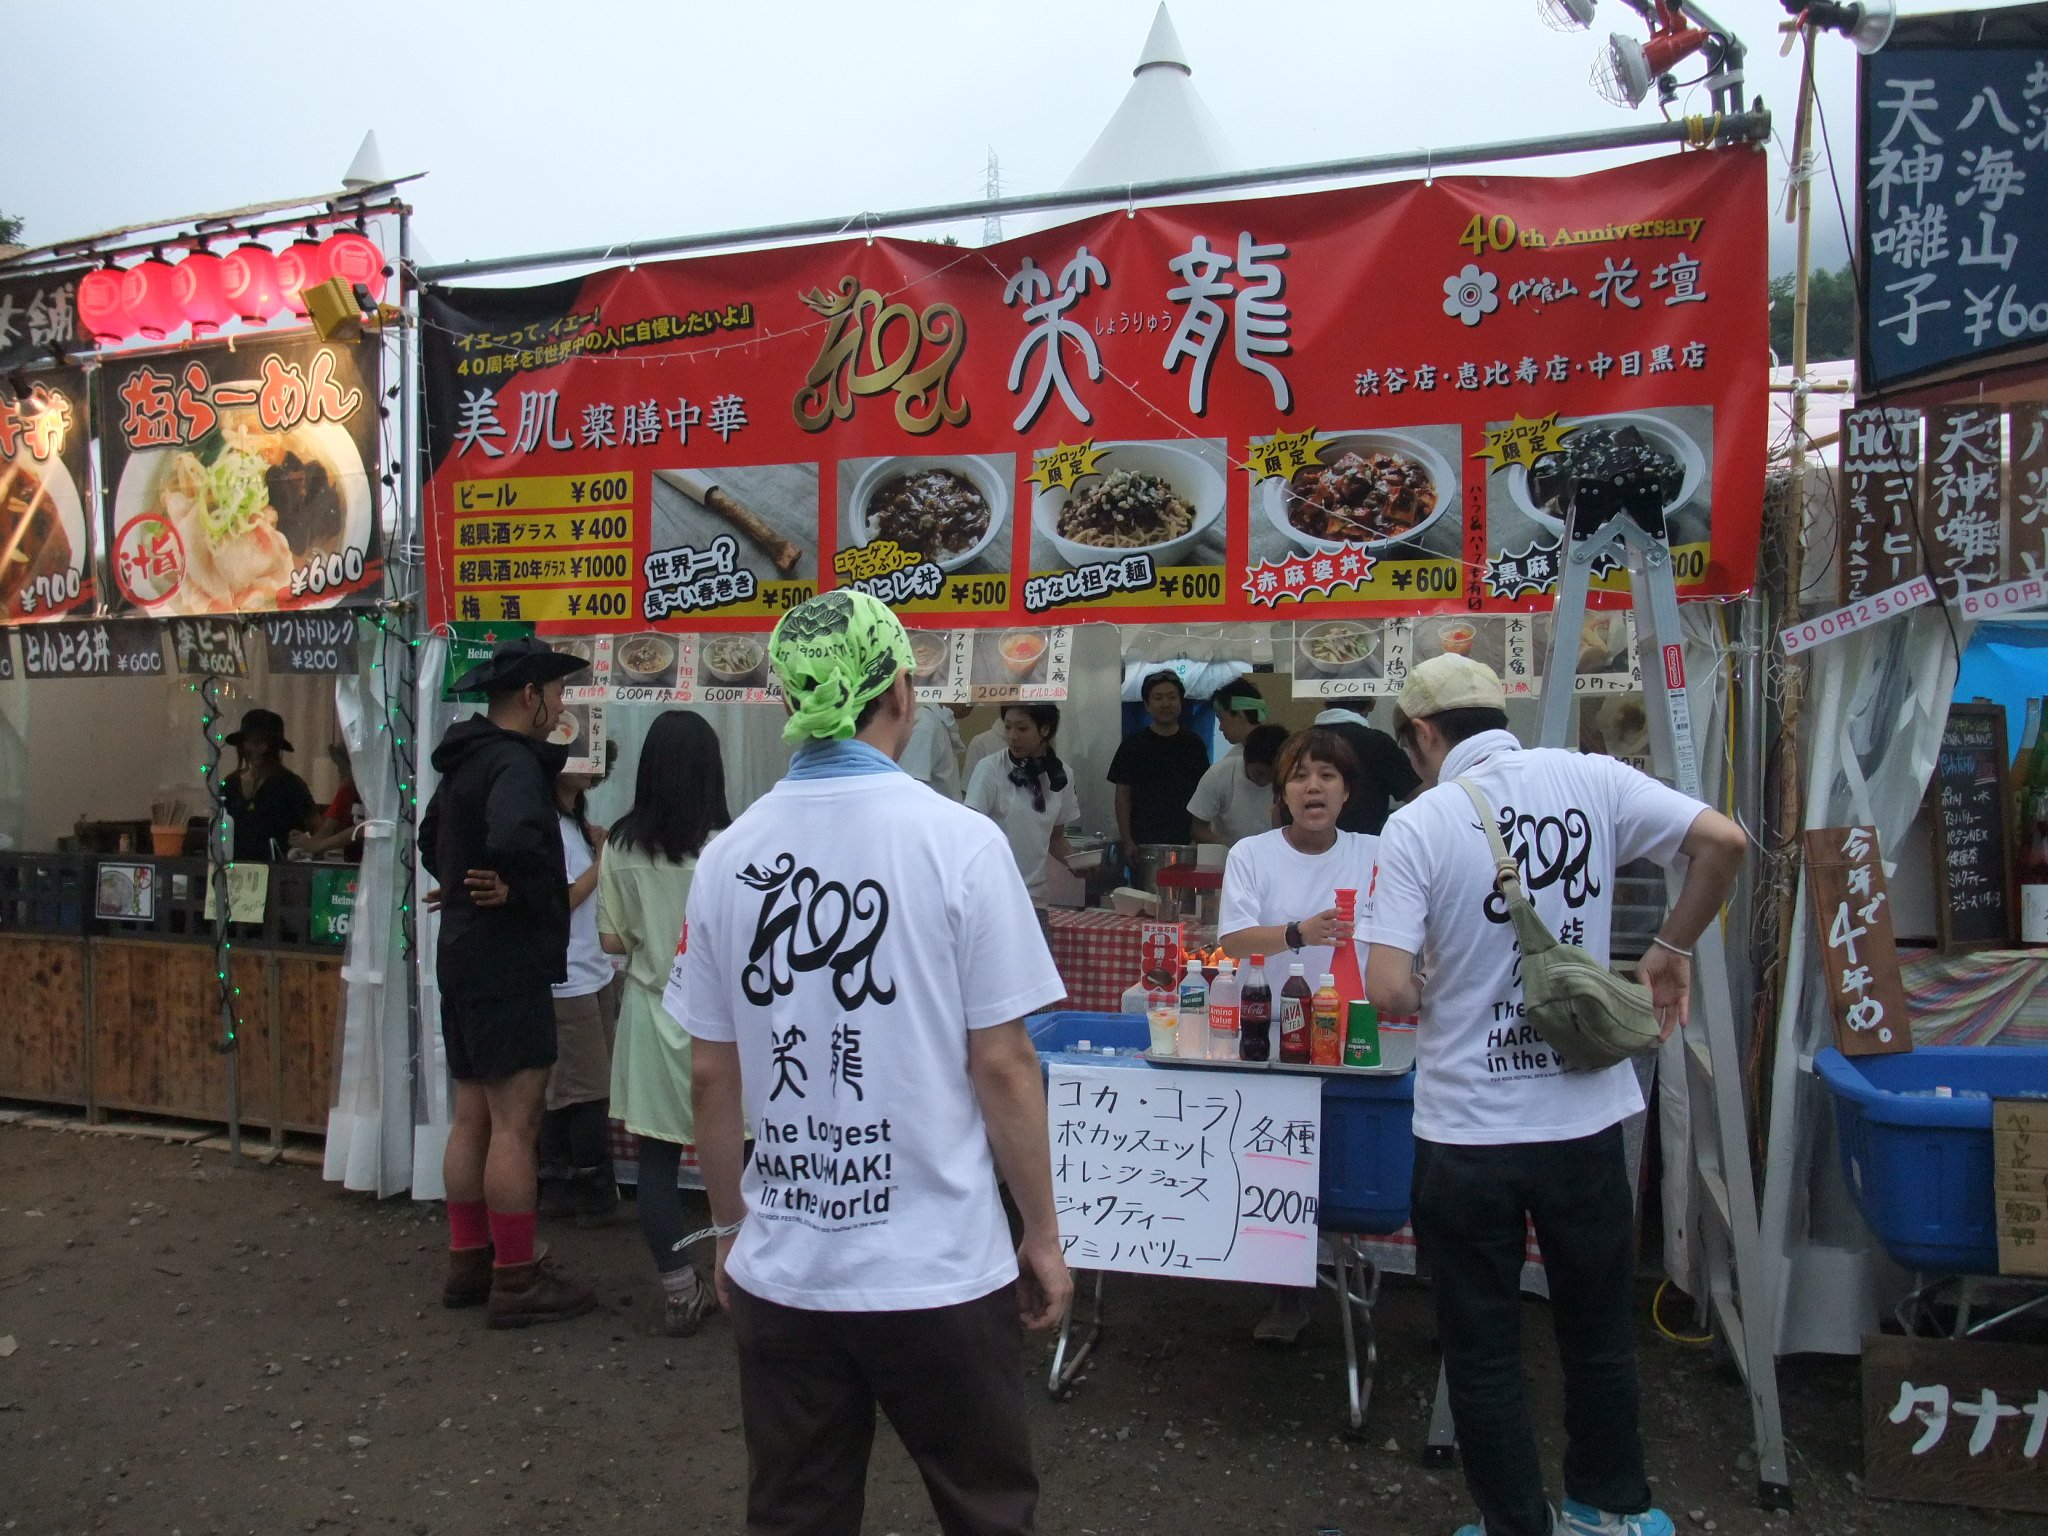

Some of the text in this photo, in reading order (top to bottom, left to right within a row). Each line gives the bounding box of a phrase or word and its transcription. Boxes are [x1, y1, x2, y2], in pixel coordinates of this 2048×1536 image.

[1956, 86, 2024, 270] 八海山
[1868, 79, 1950, 345] 天神囃子
[1459, 213, 1704, 255] 40th Anniversary
[1589, 252, 1708, 308] 花壇
[1095, 310, 1174, 337] しょうりゅう
[120, 349, 362, 449] 塩らーめん
[454, 387, 749, 459] 美肌 薬膳中華
[1490, 420, 1550, 446] フジロック
[1253, 434, 1308, 457] フジロック
[1502, 435, 1548, 461] 限定
[1849, 422, 1920, 456] HOT
[1039, 444, 1088, 470] フジロック
[1264, 448, 1307, 472] 限定
[1048, 464, 1084, 483] 限定
[459, 478, 628, 509] ビール ¥600
[459, 516, 628, 546] 紹興酒グラス ¥400
[291, 548, 363, 597] ¥600
[570, 554, 627, 579] ¥1000
[1256, 549, 1457, 593] 赤麻婆丼 ¥600
[20, 568, 81, 613] ¥700
[951, 581, 1007, 605] ¥500
[1159, 573, 1220, 599] ¥600
[1964, 581, 2042, 614] 600円
[568, 592, 627, 617] ¥400
[177, 619, 242, 654] 生ビール
[268, 618, 354, 647] ソフトドリンク
[118, 653, 162, 673] ¥600
[200, 654, 236, 674] ¥600
[292, 649, 338, 670] ¥200
[616, 687, 653, 701] 600円
[705, 687, 743, 701] 600円
[978, 686, 1019, 699] 200円
[1319, 679, 1375, 694] 600円
[1210, 1007, 1233, 1016] Amino
[1210, 1015, 1233, 1024] Value
[1487, 1053, 1508, 1073] in
[1512, 1050, 1548, 1071] the
[1058, 1081, 1228, 1131] コカ・コーラ
[1243, 1115, 1317, 1155] 各種
[760, 1180, 779, 1208] in
[1241, 1185, 1318, 1226] 200円
[1055, 1195, 1186, 1230] ジャワティー
